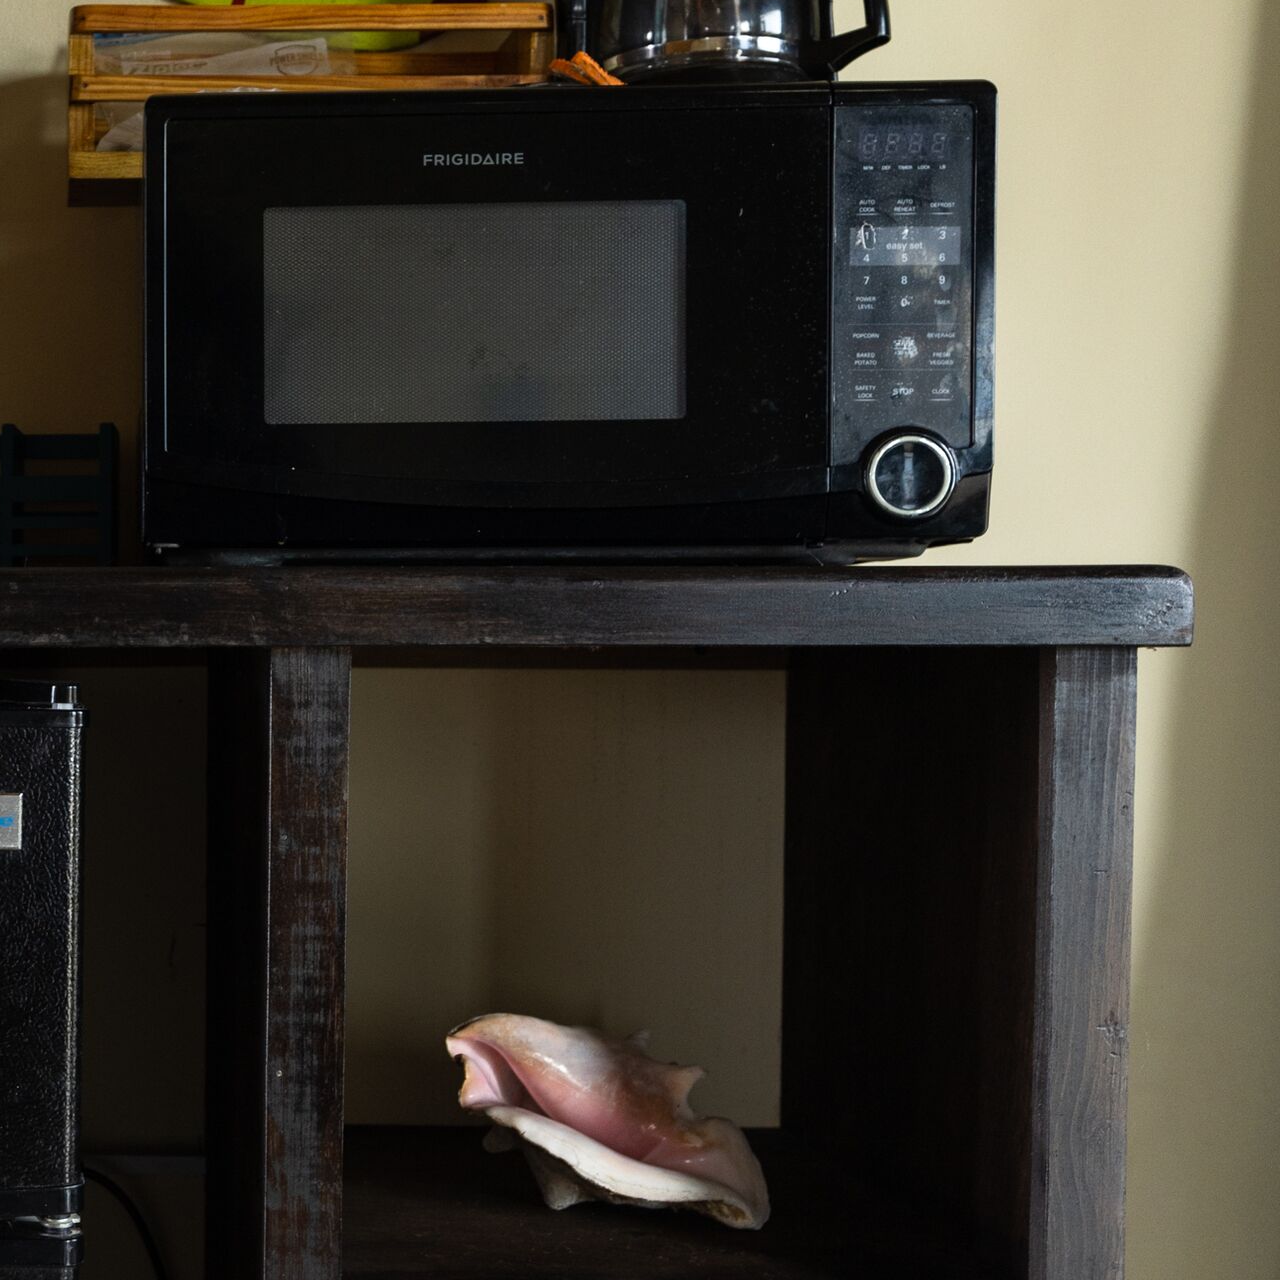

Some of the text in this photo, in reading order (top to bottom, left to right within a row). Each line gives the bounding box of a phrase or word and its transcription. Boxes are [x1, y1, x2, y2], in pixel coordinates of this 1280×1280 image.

[423, 153, 524, 166] FRIGIDAIRE
[902, 229, 908, 239] 2
[939, 231, 946, 239] 3
[863, 254, 869, 262] 4
[902, 254, 907, 262] 5
[939, 253, 945, 262] 6
[864, 276, 869, 285] 7
[901, 276, 907, 284] 8
[939, 275, 945, 284] 9
